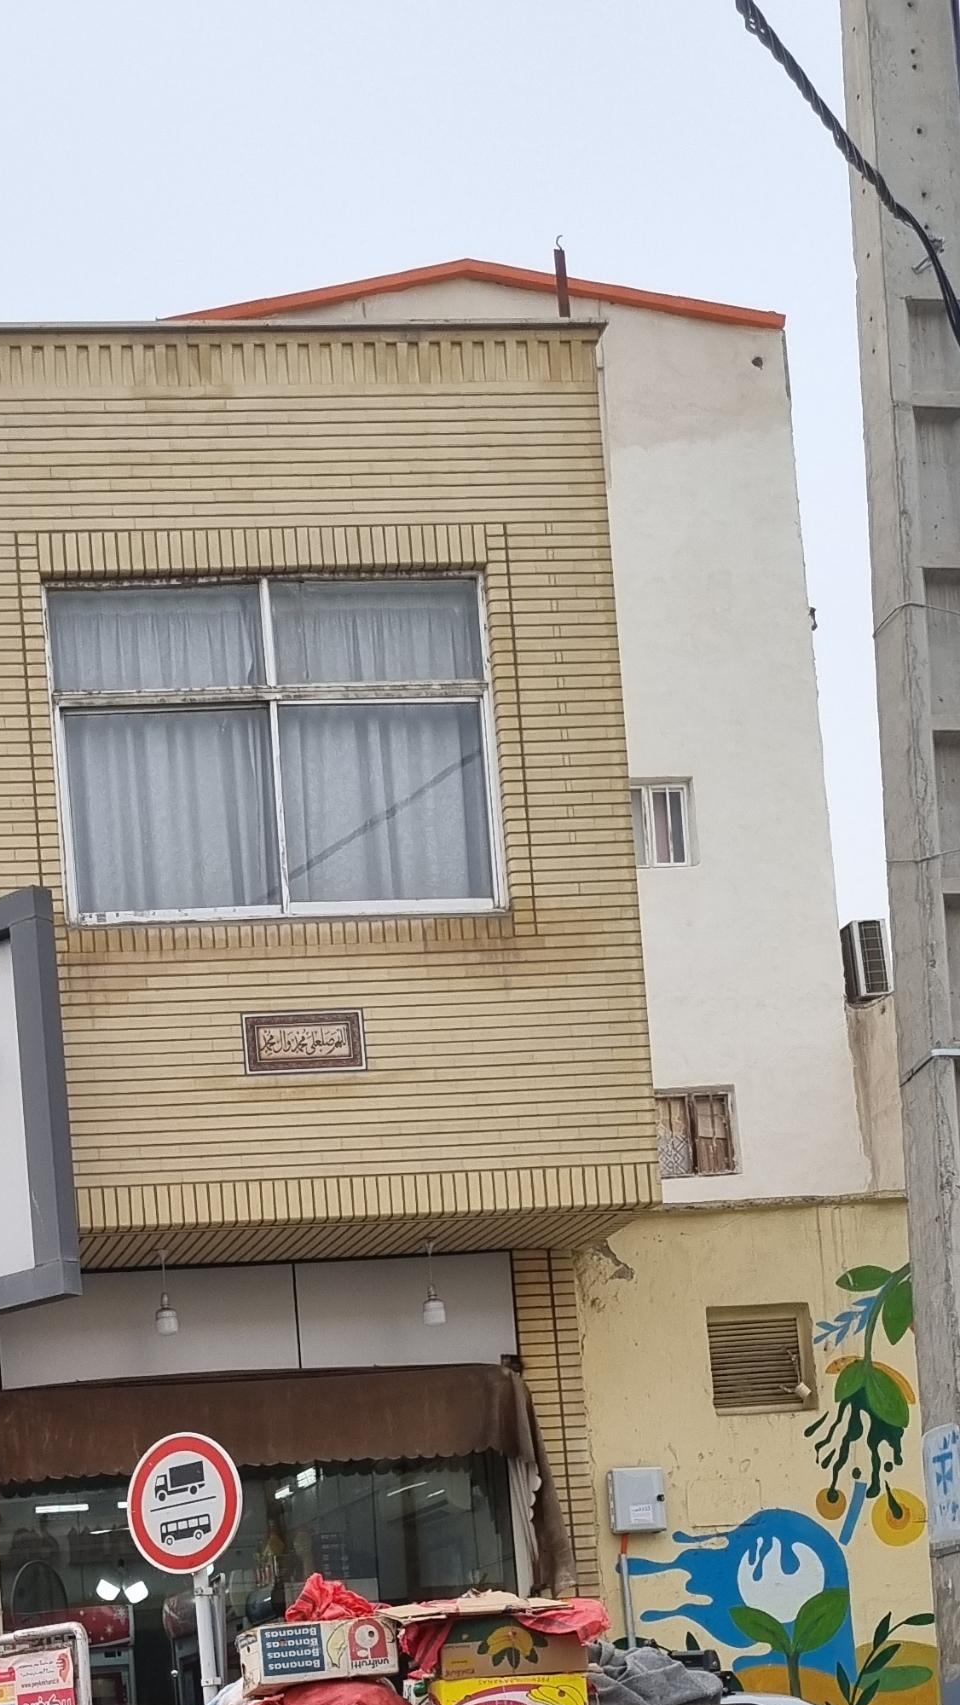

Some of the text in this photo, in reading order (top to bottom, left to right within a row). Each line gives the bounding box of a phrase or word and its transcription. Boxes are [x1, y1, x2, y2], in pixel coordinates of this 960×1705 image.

[264, 1627, 317, 1639] Bananas
[267, 1647, 320, 1660] Bananas
[268, 1659, 321, 1671] Bananas
[351, 1657, 390, 1670] unifrutti
